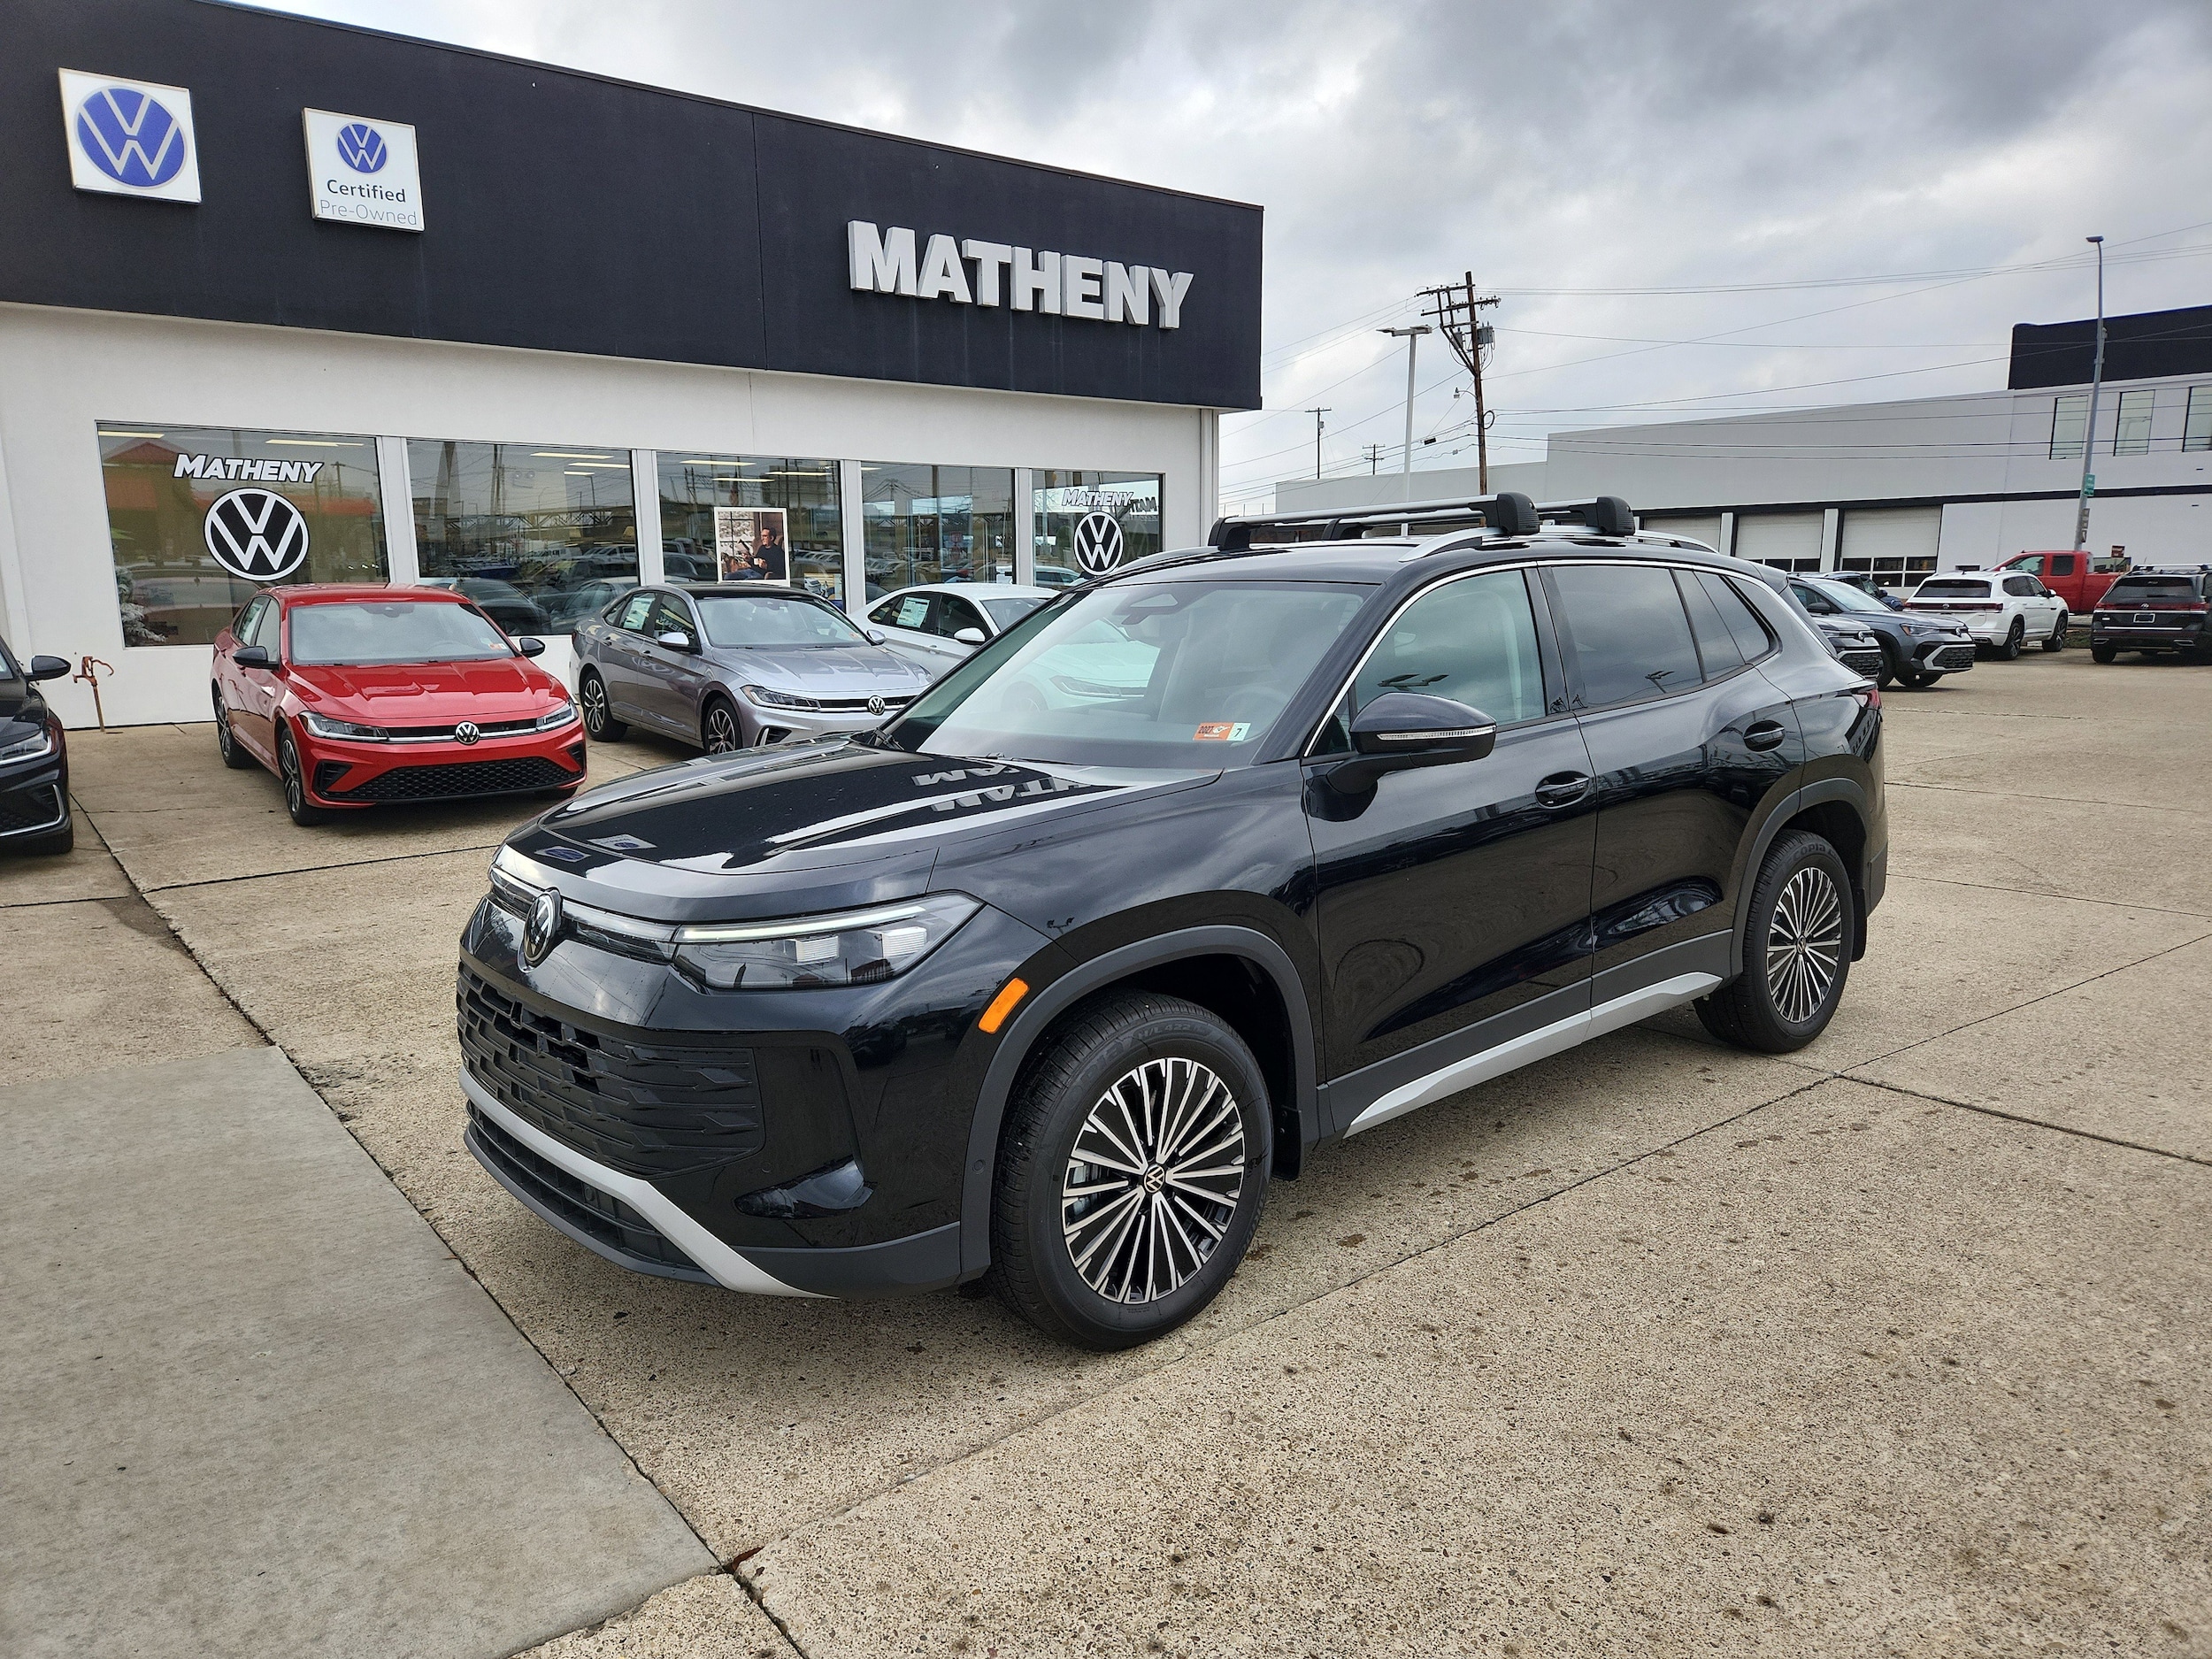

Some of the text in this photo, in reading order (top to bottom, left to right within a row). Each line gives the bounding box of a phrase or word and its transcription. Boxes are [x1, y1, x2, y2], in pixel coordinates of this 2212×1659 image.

[76, 87, 184, 186] VW
[336, 123, 388, 173] VW
[327, 179, 407, 204] Certified
[320, 199, 418, 226] Pre-Owned
[848, 219, 1194, 330] MATHENY
[173, 453, 324, 483] MATHENY
[1062, 489, 1133, 507] MATHENY
[205, 488, 308, 577] VW
[1075, 511, 1123, 573] VW
[1234, 728, 1242, 737] 7
